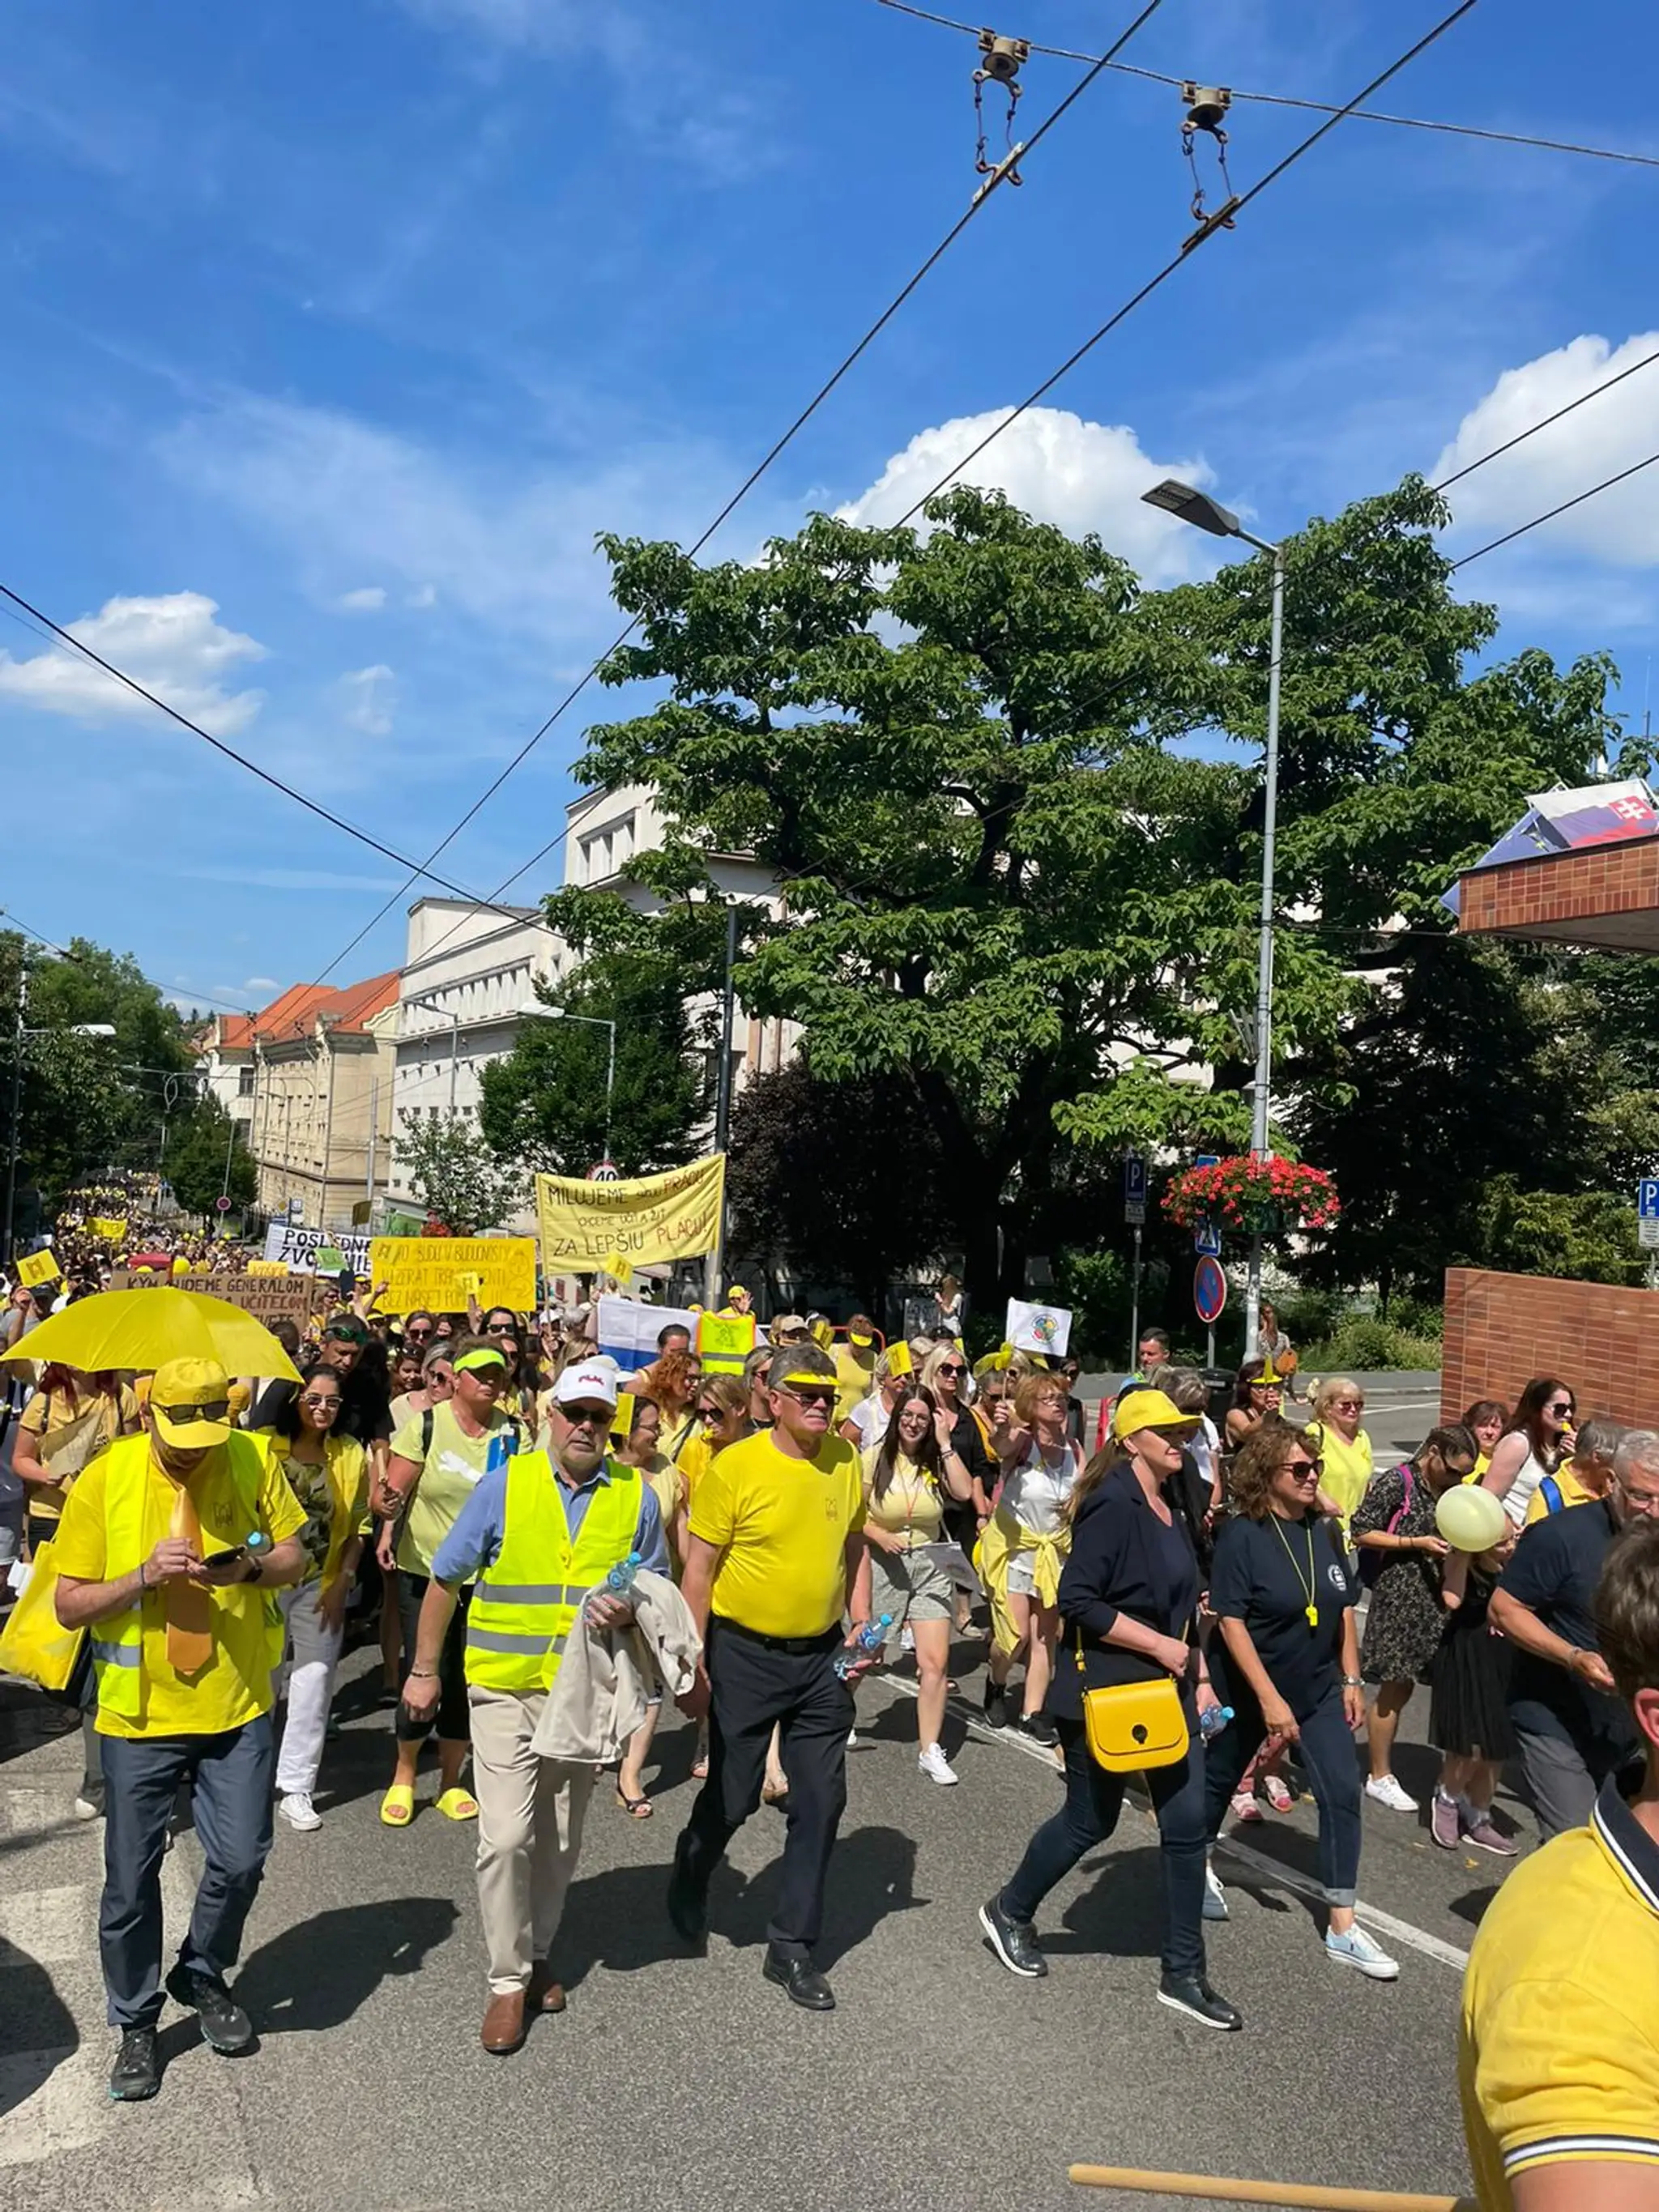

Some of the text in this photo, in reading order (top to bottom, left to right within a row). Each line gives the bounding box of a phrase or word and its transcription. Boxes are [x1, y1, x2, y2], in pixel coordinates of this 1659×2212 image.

[1131, 1162, 1141, 1187] P
[548, 1186, 628, 1206] MILUJEME
[1645, 1183, 1657, 1205] P
[553, 1238, 578, 1257] ZA
[586, 1228, 645, 1255] LEPŠIU
